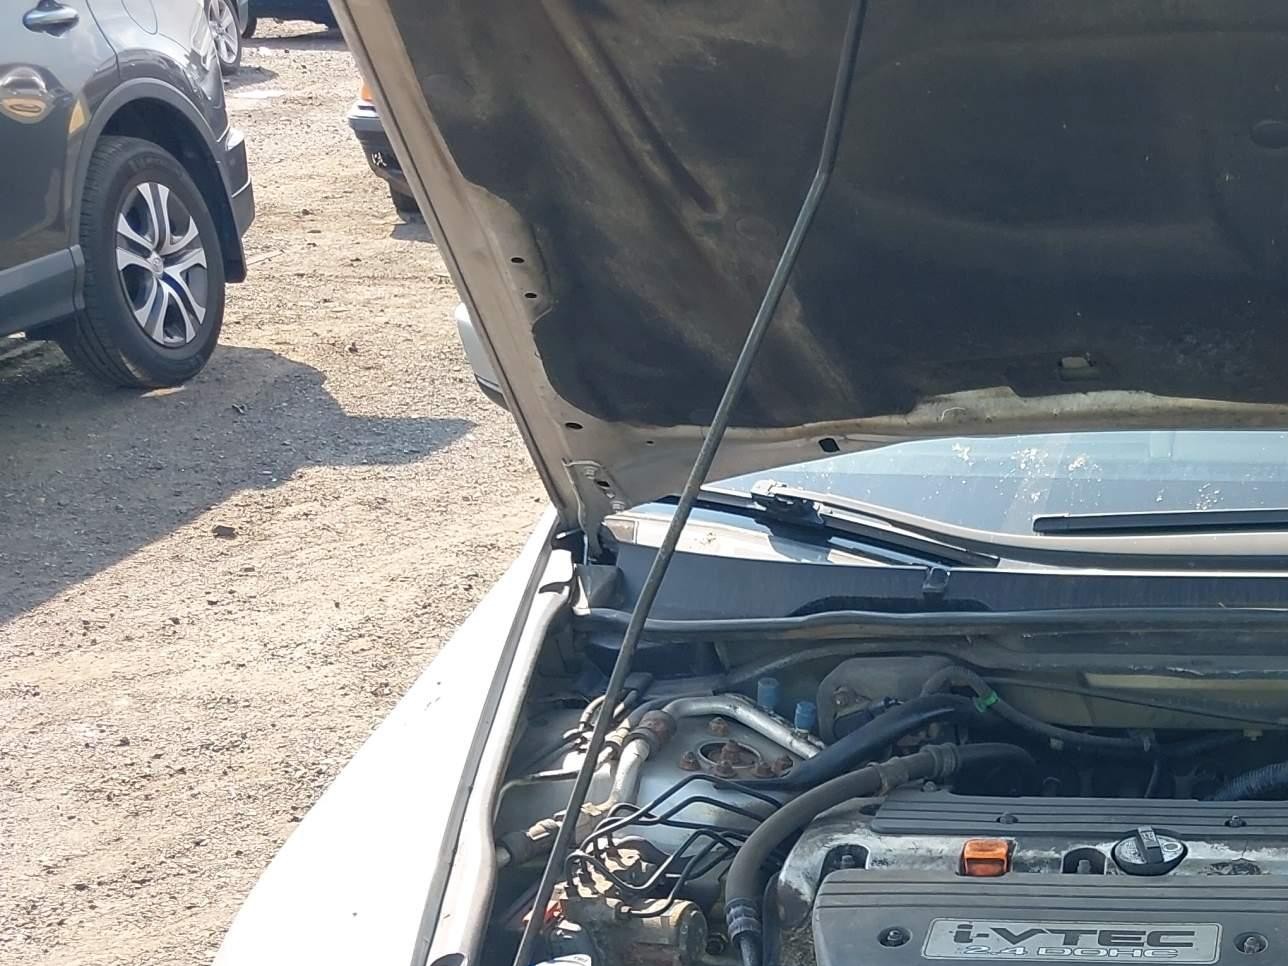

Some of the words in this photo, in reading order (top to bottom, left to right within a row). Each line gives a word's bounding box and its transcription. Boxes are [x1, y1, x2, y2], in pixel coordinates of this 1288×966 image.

[953, 923, 1196, 948] i-VTEC
[963, 945, 1029, 958] 2.4
[1036, 946, 1180, 959] DOHC
